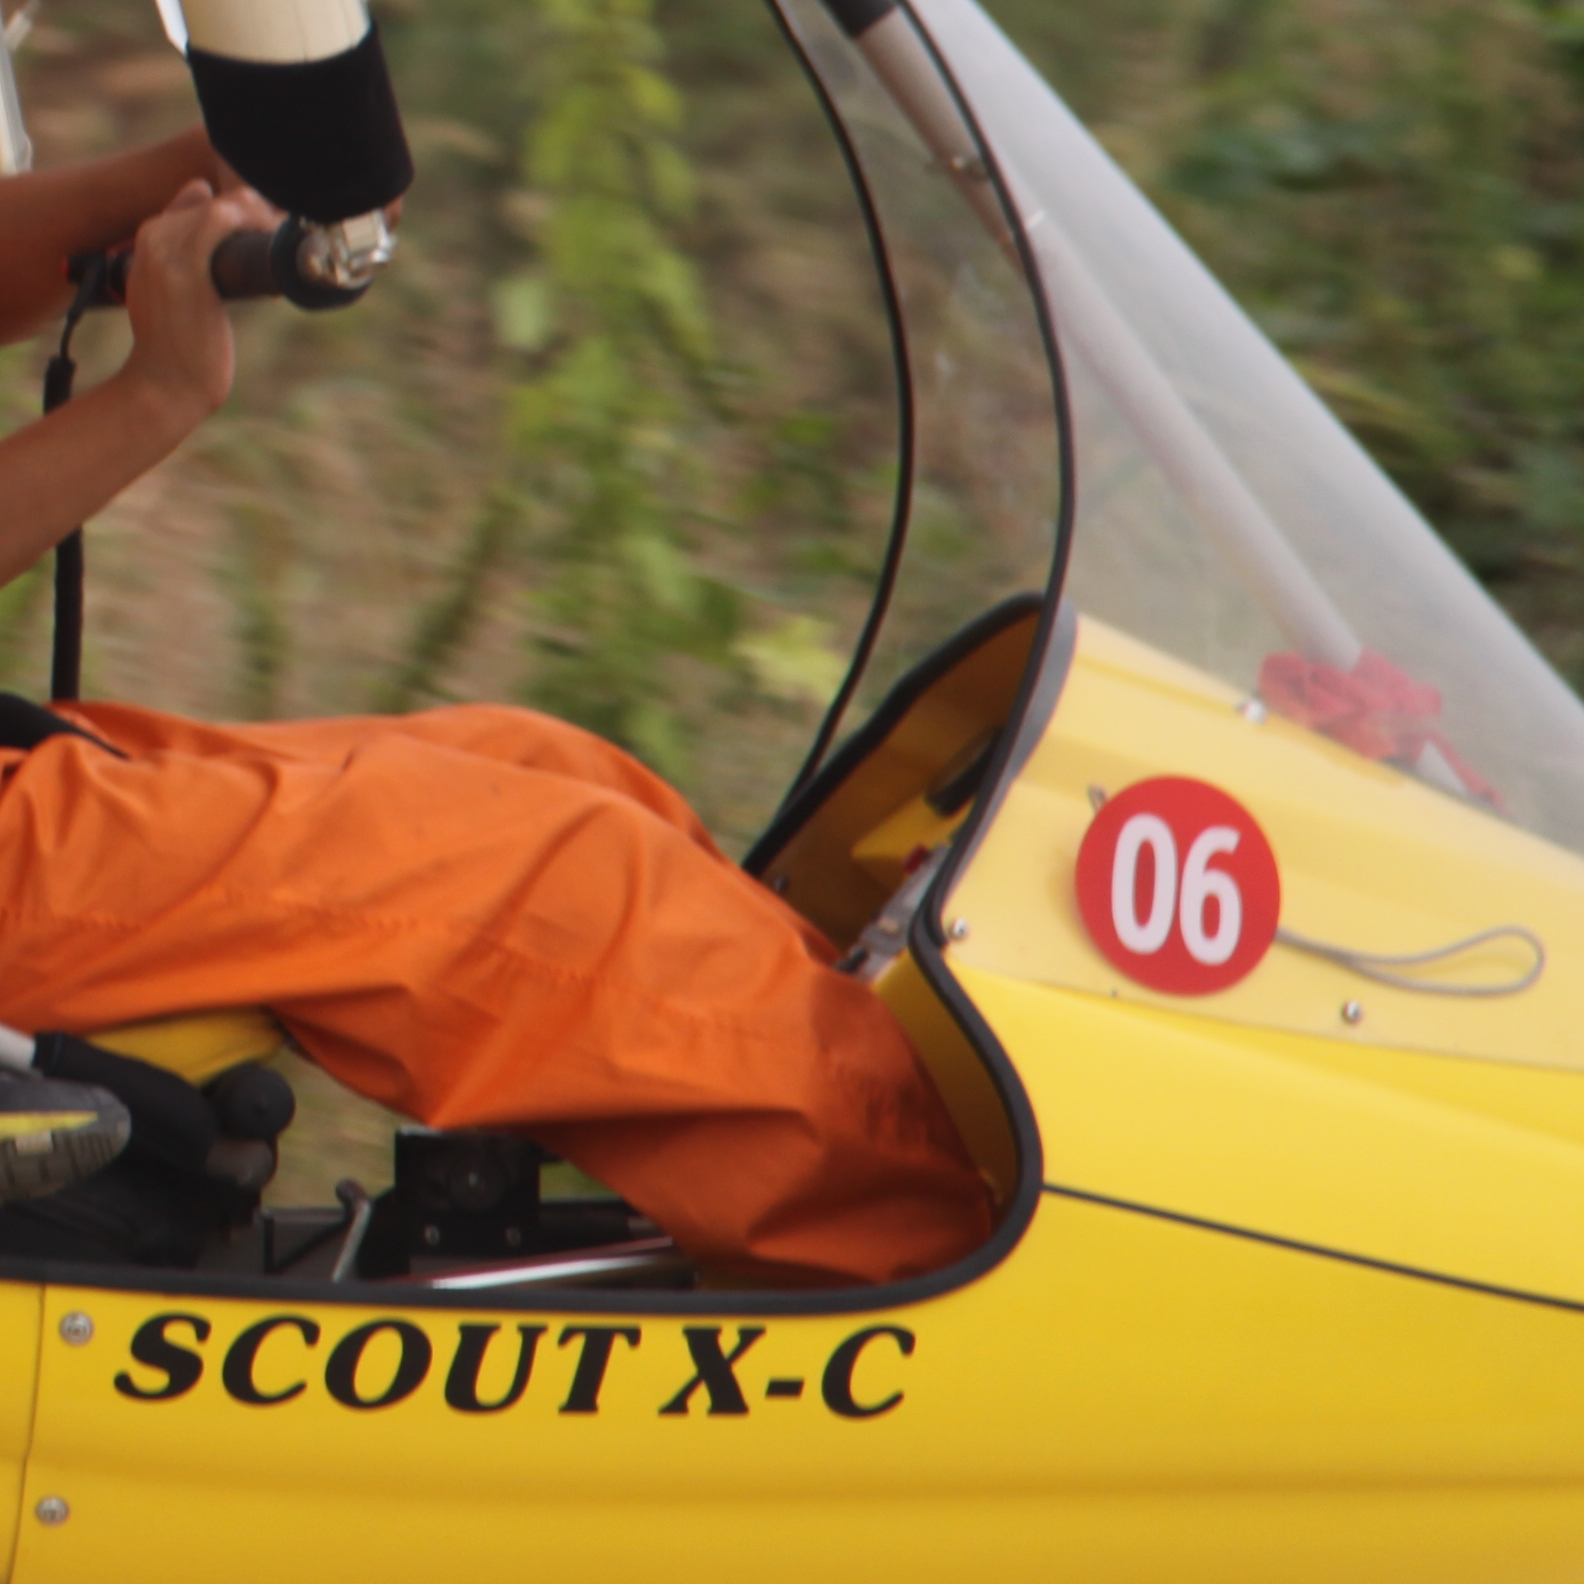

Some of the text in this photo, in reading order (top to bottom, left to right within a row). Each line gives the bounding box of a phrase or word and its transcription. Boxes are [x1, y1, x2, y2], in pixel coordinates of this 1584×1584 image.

[1111, 812, 1242, 966] 06
[113, 1312, 916, 1419] SCOUT X-C
